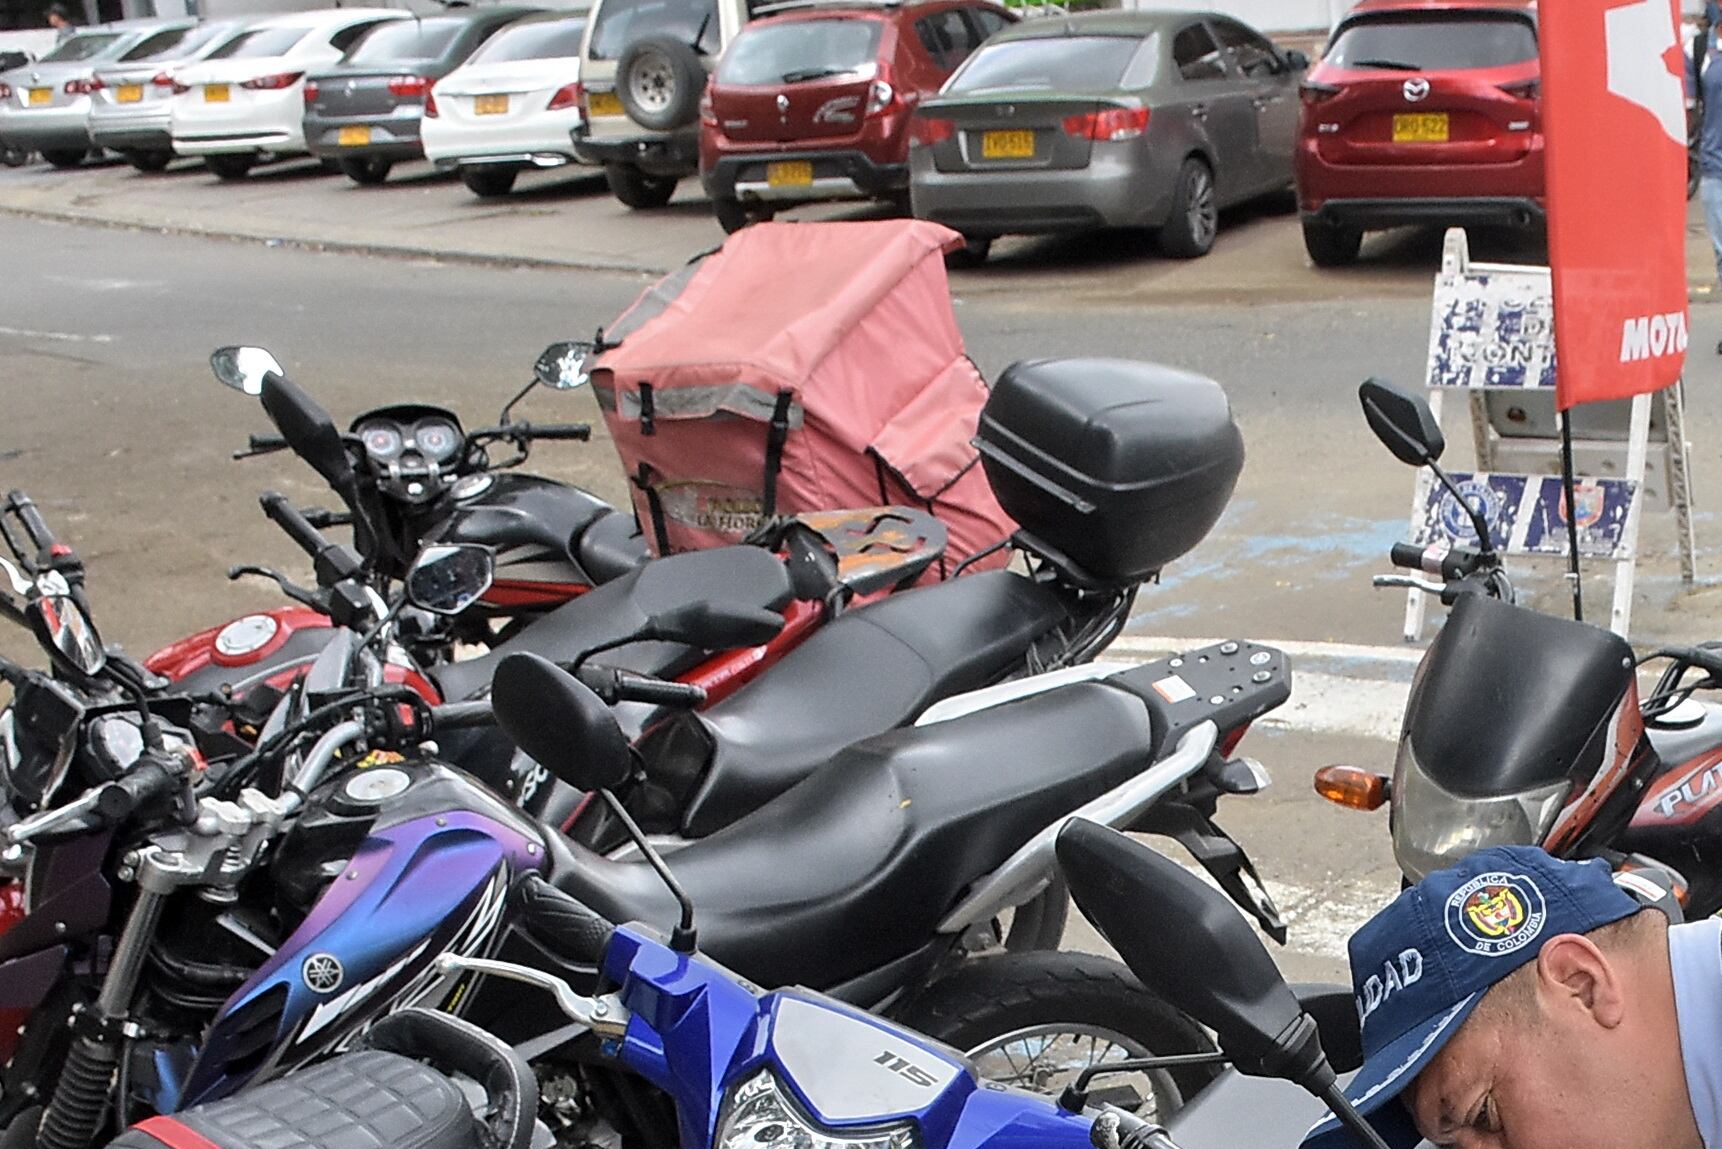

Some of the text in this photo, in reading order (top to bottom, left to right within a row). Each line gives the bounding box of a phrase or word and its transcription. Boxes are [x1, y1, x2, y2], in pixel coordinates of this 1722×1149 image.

[1475, 911, 1542, 952] DE COLOMBIA
[873, 1050, 939, 1088] 115
